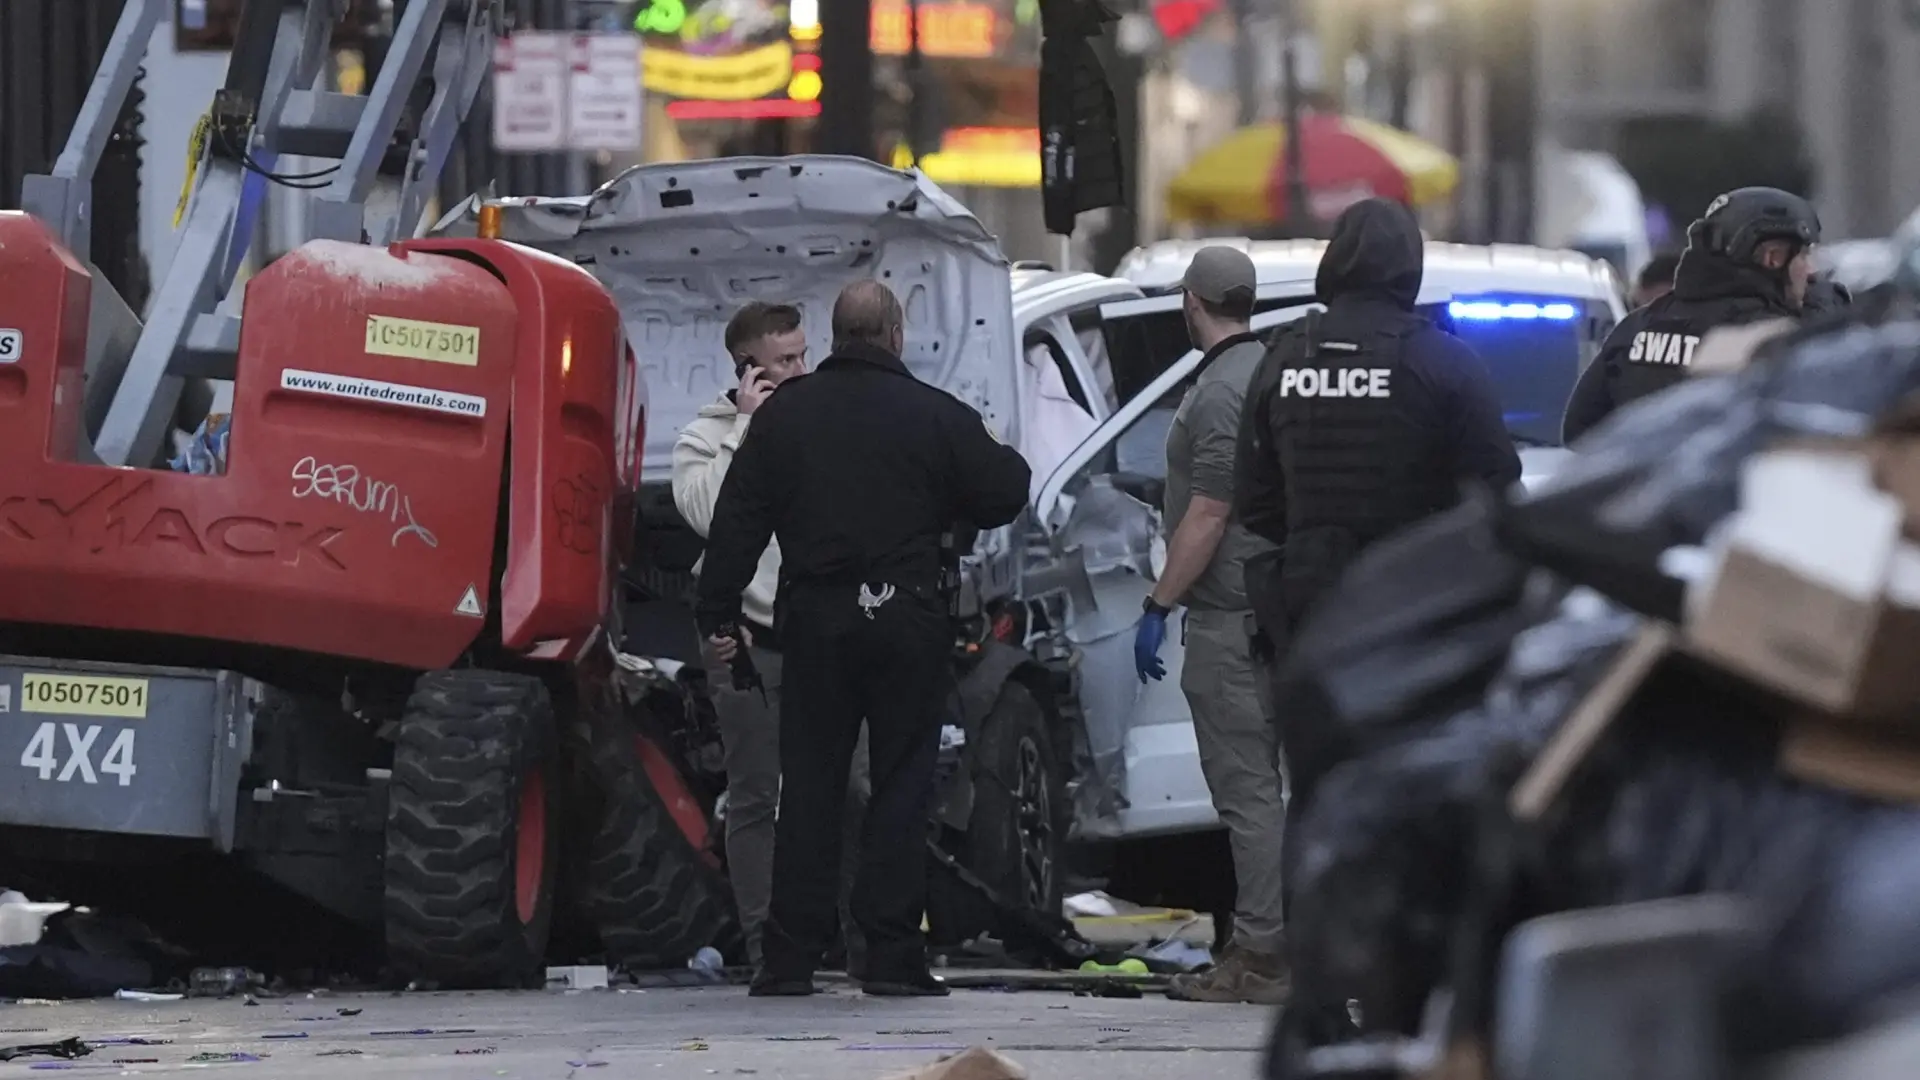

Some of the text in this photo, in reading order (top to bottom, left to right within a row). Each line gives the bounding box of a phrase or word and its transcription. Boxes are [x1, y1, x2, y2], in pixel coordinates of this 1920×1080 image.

[368, 322, 475, 355] 10507501
[1628, 331, 1700, 366] SWAT
[286, 375, 480, 413] www.unitedrentals.com
[1279, 367, 1392, 398] POLICE
[24, 680, 144, 708] 10507501
[20, 721, 137, 786] 4X4
